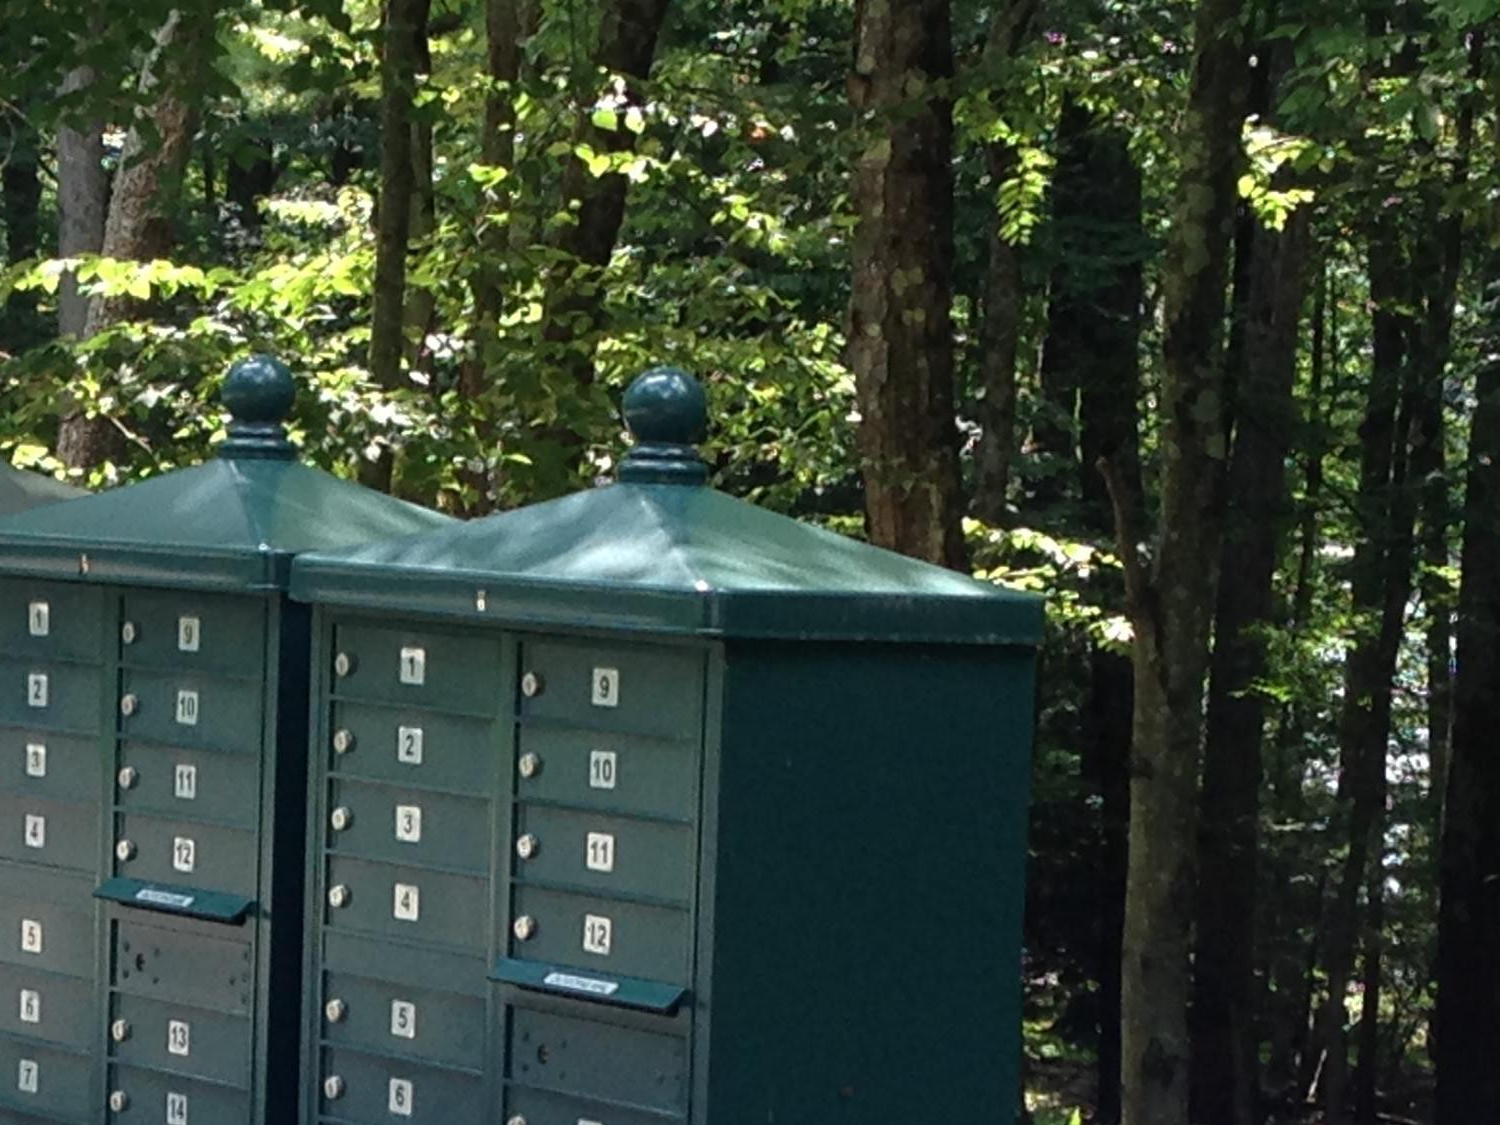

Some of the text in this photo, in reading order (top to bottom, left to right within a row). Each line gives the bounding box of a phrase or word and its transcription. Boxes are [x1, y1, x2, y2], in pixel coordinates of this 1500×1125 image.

[593, 758, 613, 782] 10
[590, 841, 608, 864] 11
[587, 923, 607, 948] 12
